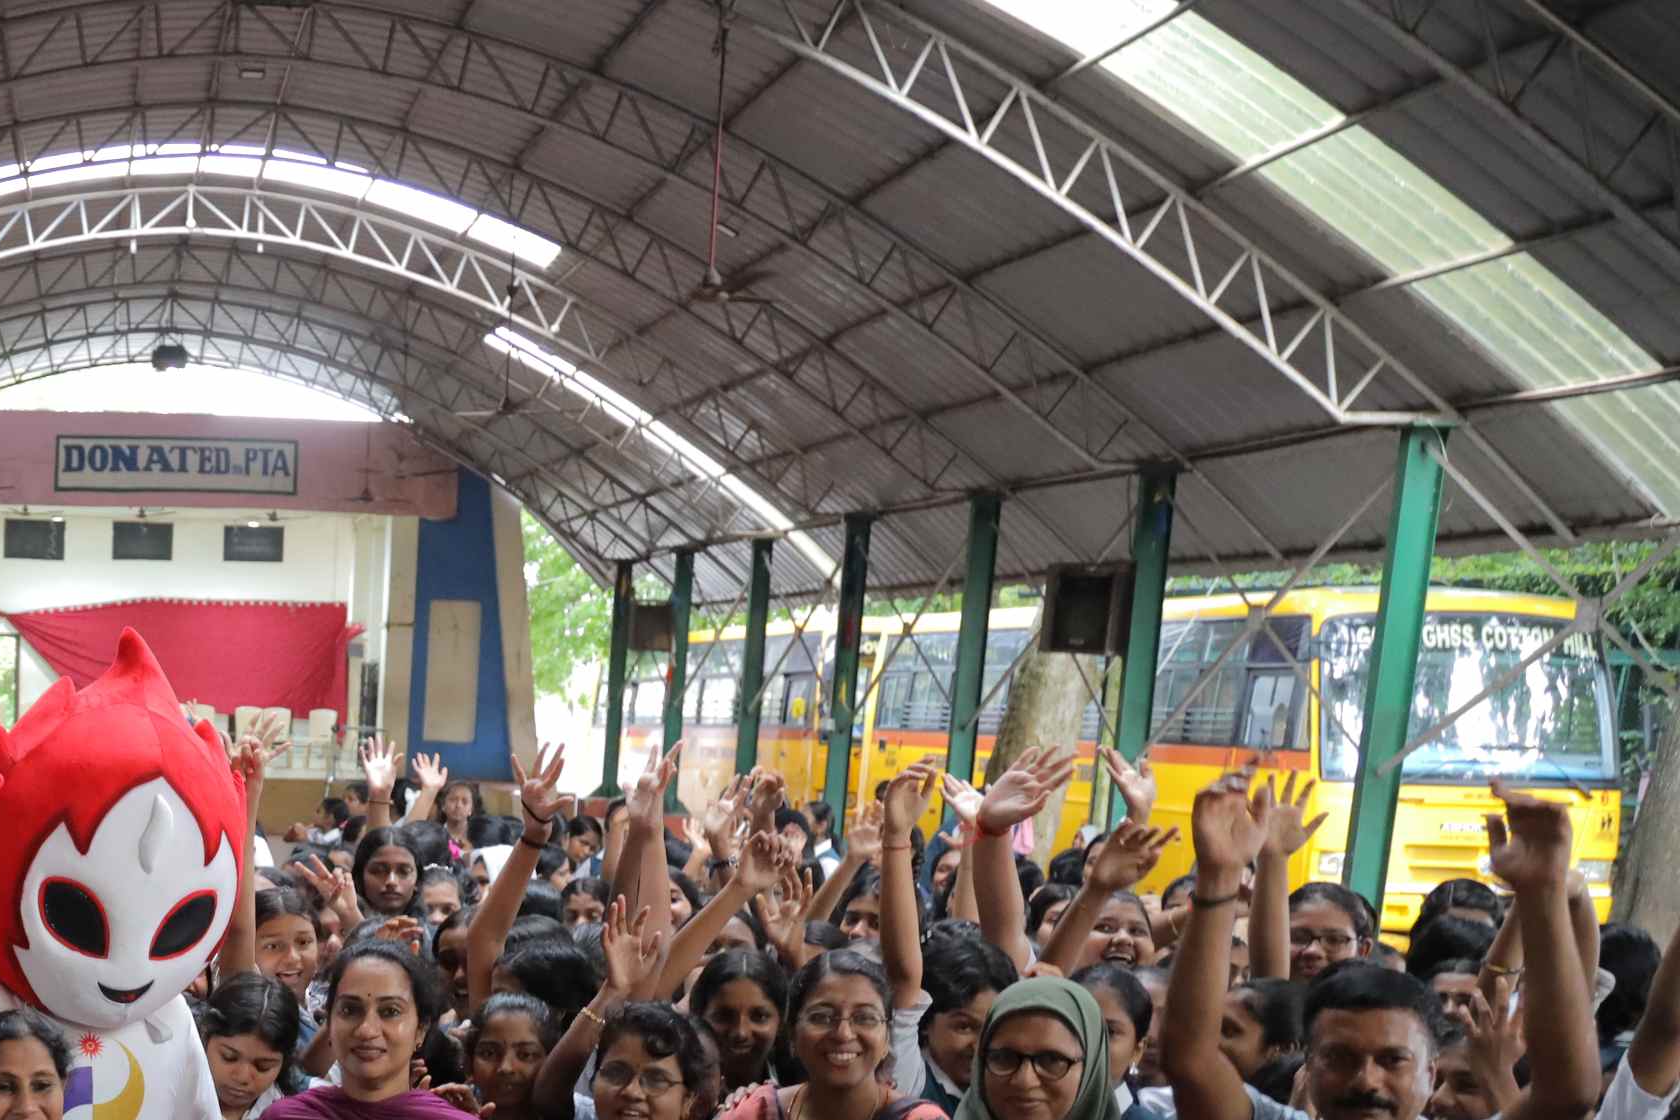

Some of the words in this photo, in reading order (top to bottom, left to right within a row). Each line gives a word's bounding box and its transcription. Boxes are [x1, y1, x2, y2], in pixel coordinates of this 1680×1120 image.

[62, 444, 231, 475] DONATED
[245, 448, 291, 477] PTA
[1422, 623, 1474, 648] GHSS
[1482, 625, 1554, 651] COTTON
